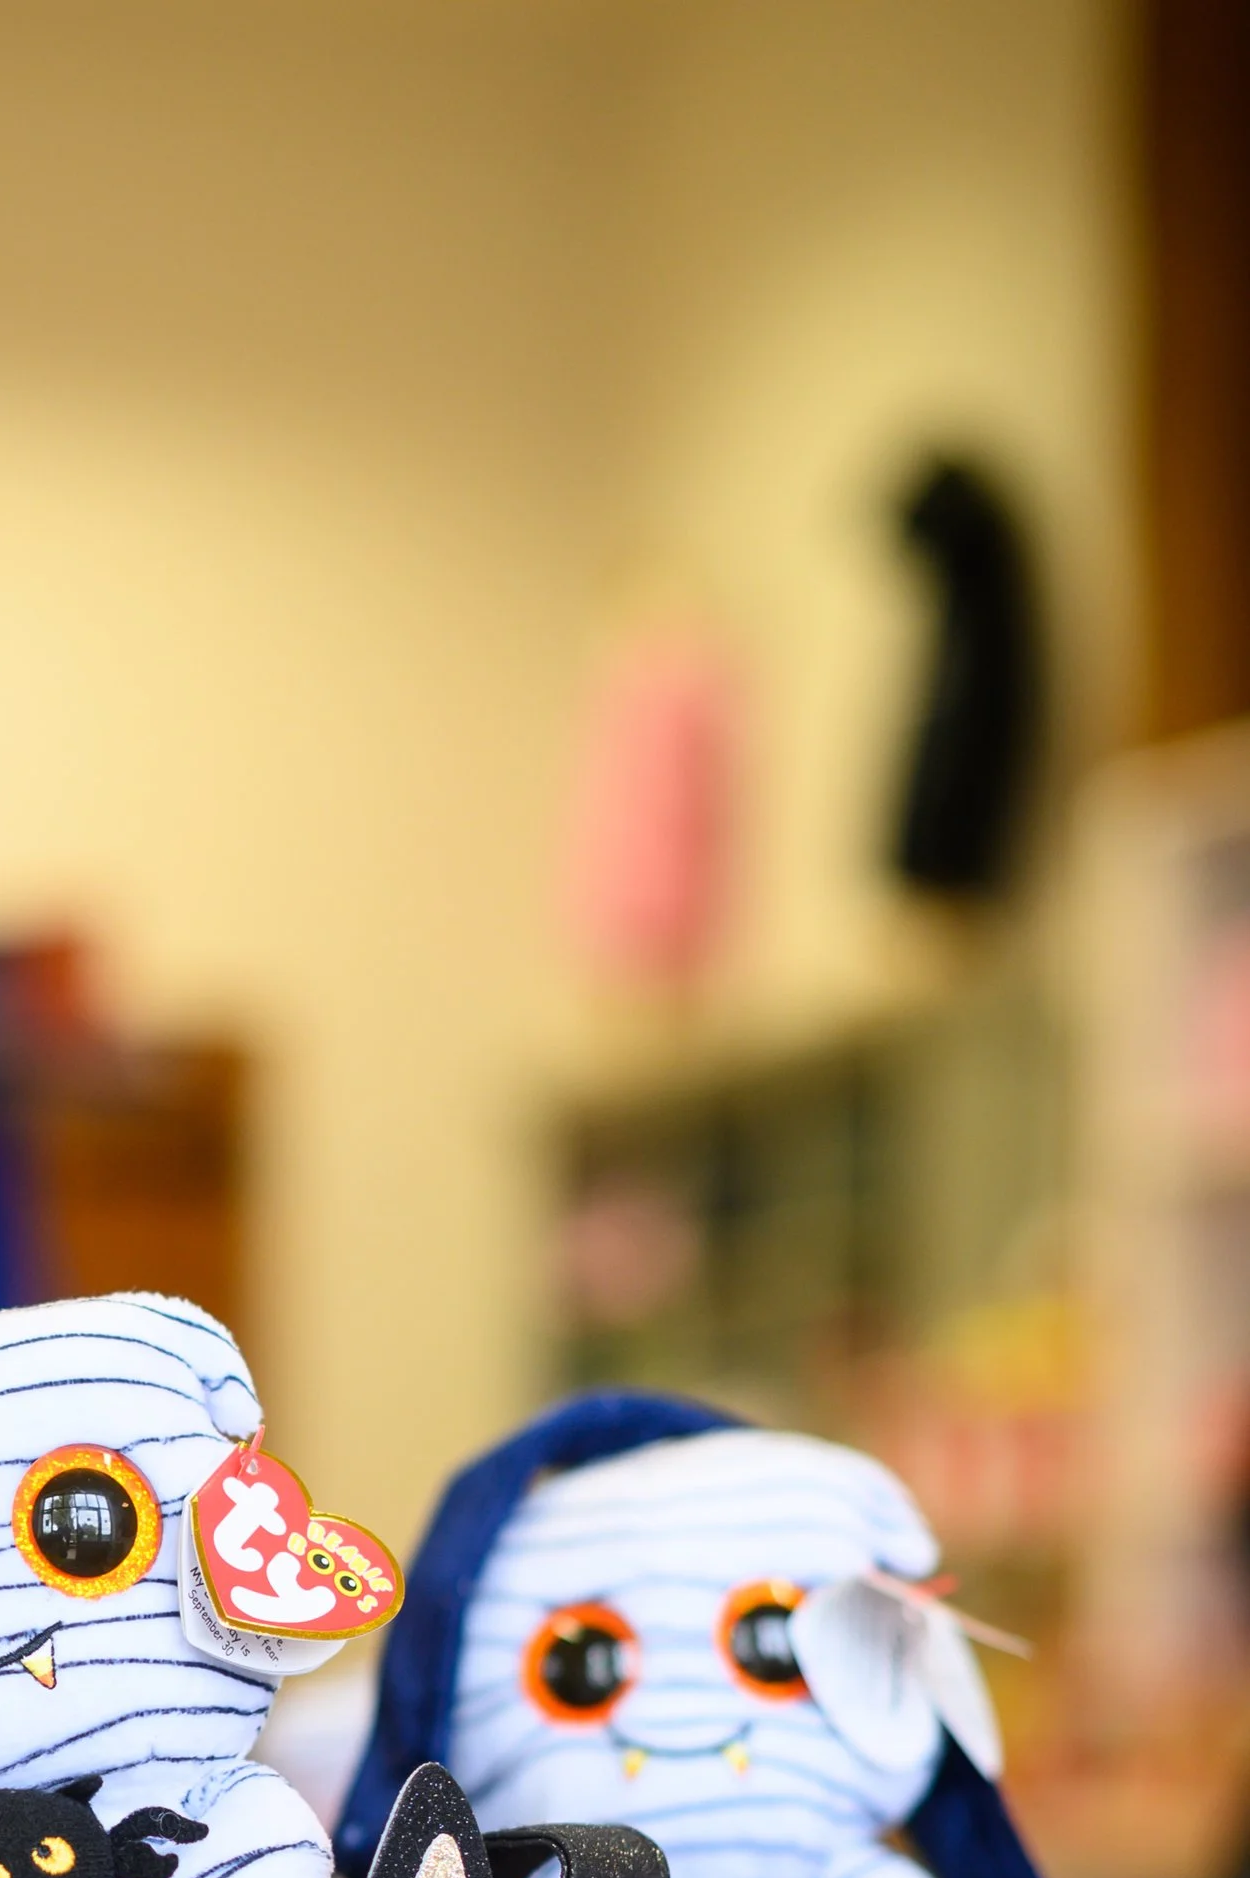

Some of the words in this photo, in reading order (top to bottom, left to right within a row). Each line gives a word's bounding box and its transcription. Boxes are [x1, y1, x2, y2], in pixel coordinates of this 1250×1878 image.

[307, 1521, 393, 1592] BEANIE
[188, 1589, 224, 1641] September
[222, 1641, 235, 1657] 30
